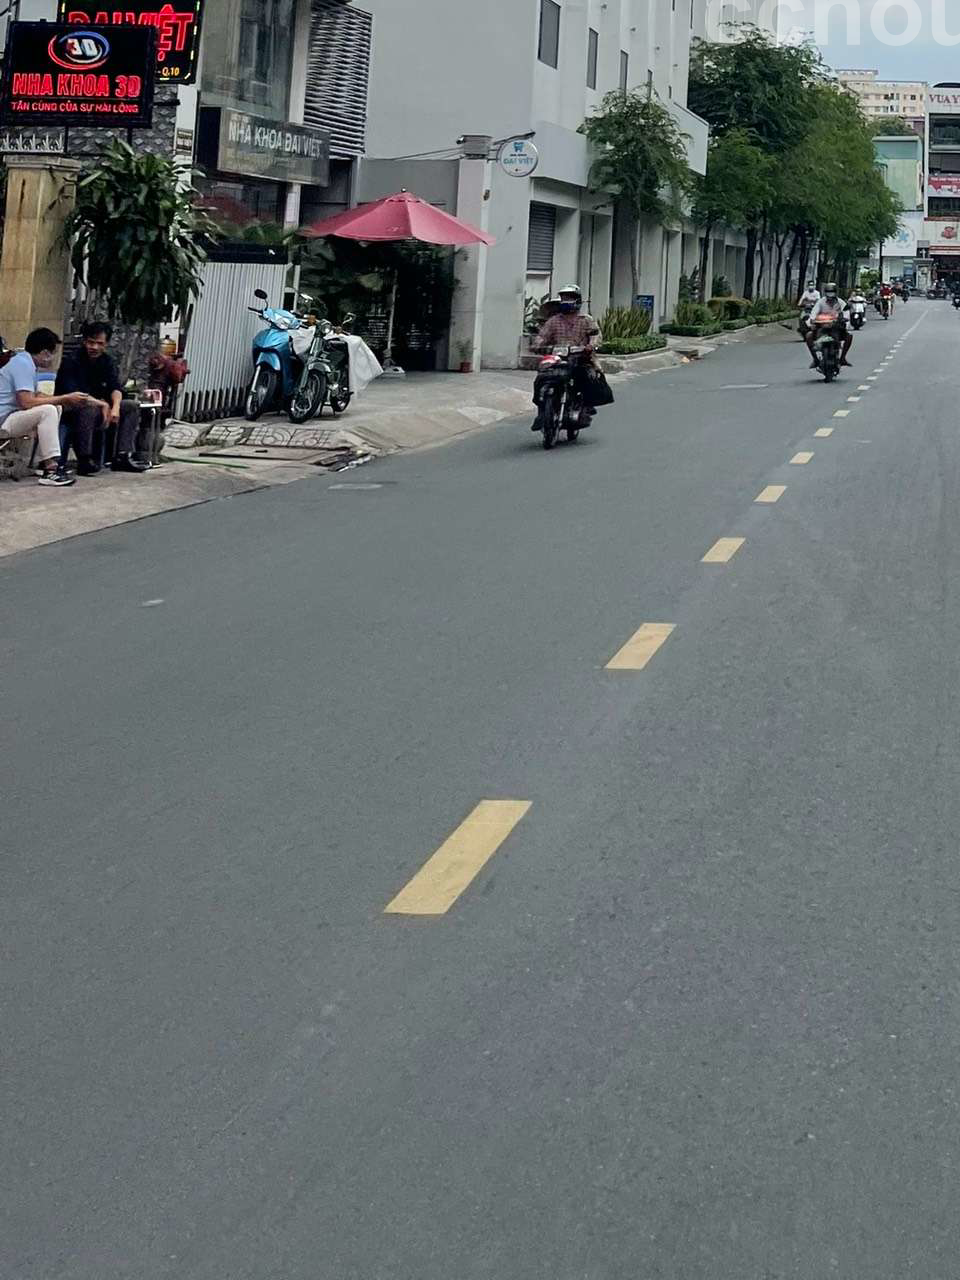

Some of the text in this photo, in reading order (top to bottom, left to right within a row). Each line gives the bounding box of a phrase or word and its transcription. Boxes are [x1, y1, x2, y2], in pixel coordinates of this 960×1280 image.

[66, 38, 99, 56] 3D
[12, 73, 141, 97] NHA KHOA 3D
[229, 121, 251, 144] NHA
[254, 126, 282, 149] KHOA
